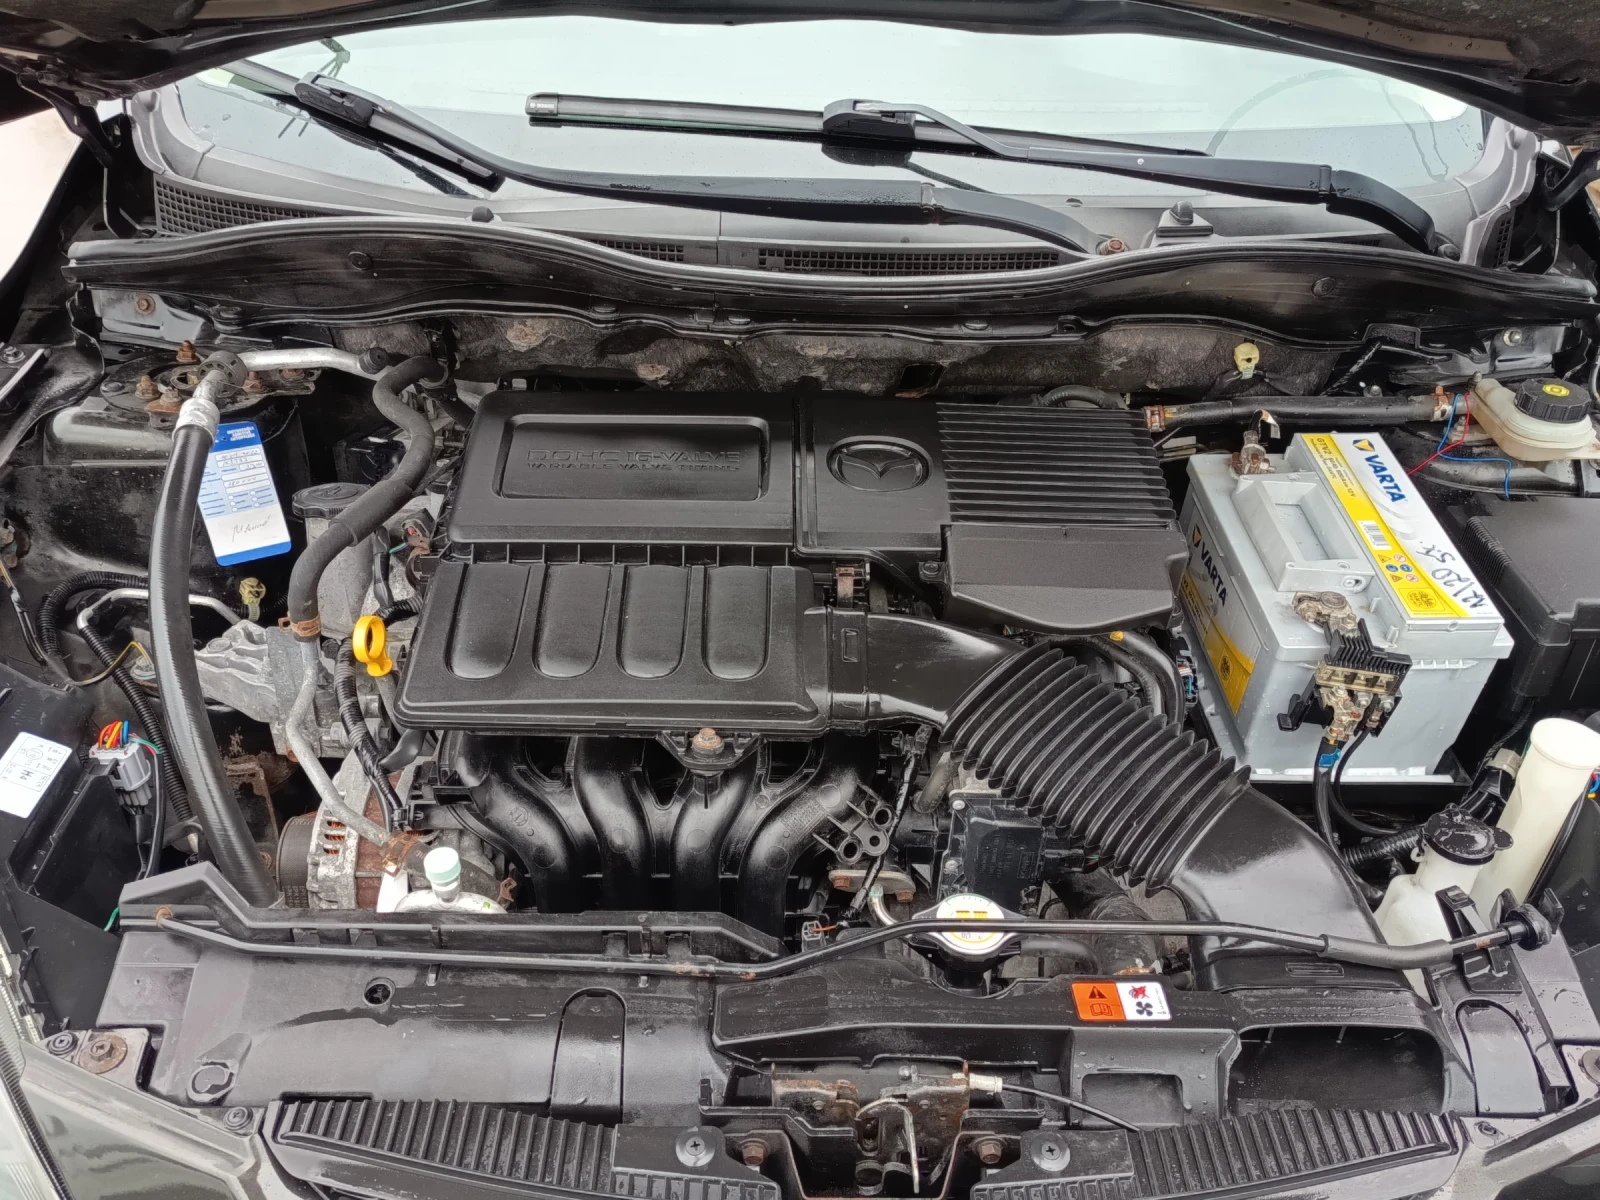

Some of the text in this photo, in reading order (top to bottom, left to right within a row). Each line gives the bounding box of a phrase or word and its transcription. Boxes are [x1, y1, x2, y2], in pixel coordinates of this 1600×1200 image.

[527, 449, 741, 464] DOHC 16-VALVE
[527, 462, 739, 472] VARIABLE VALVE TIMING
[1365, 454, 1406, 503] VARTA
[1201, 541, 1227, 607] VARTA
